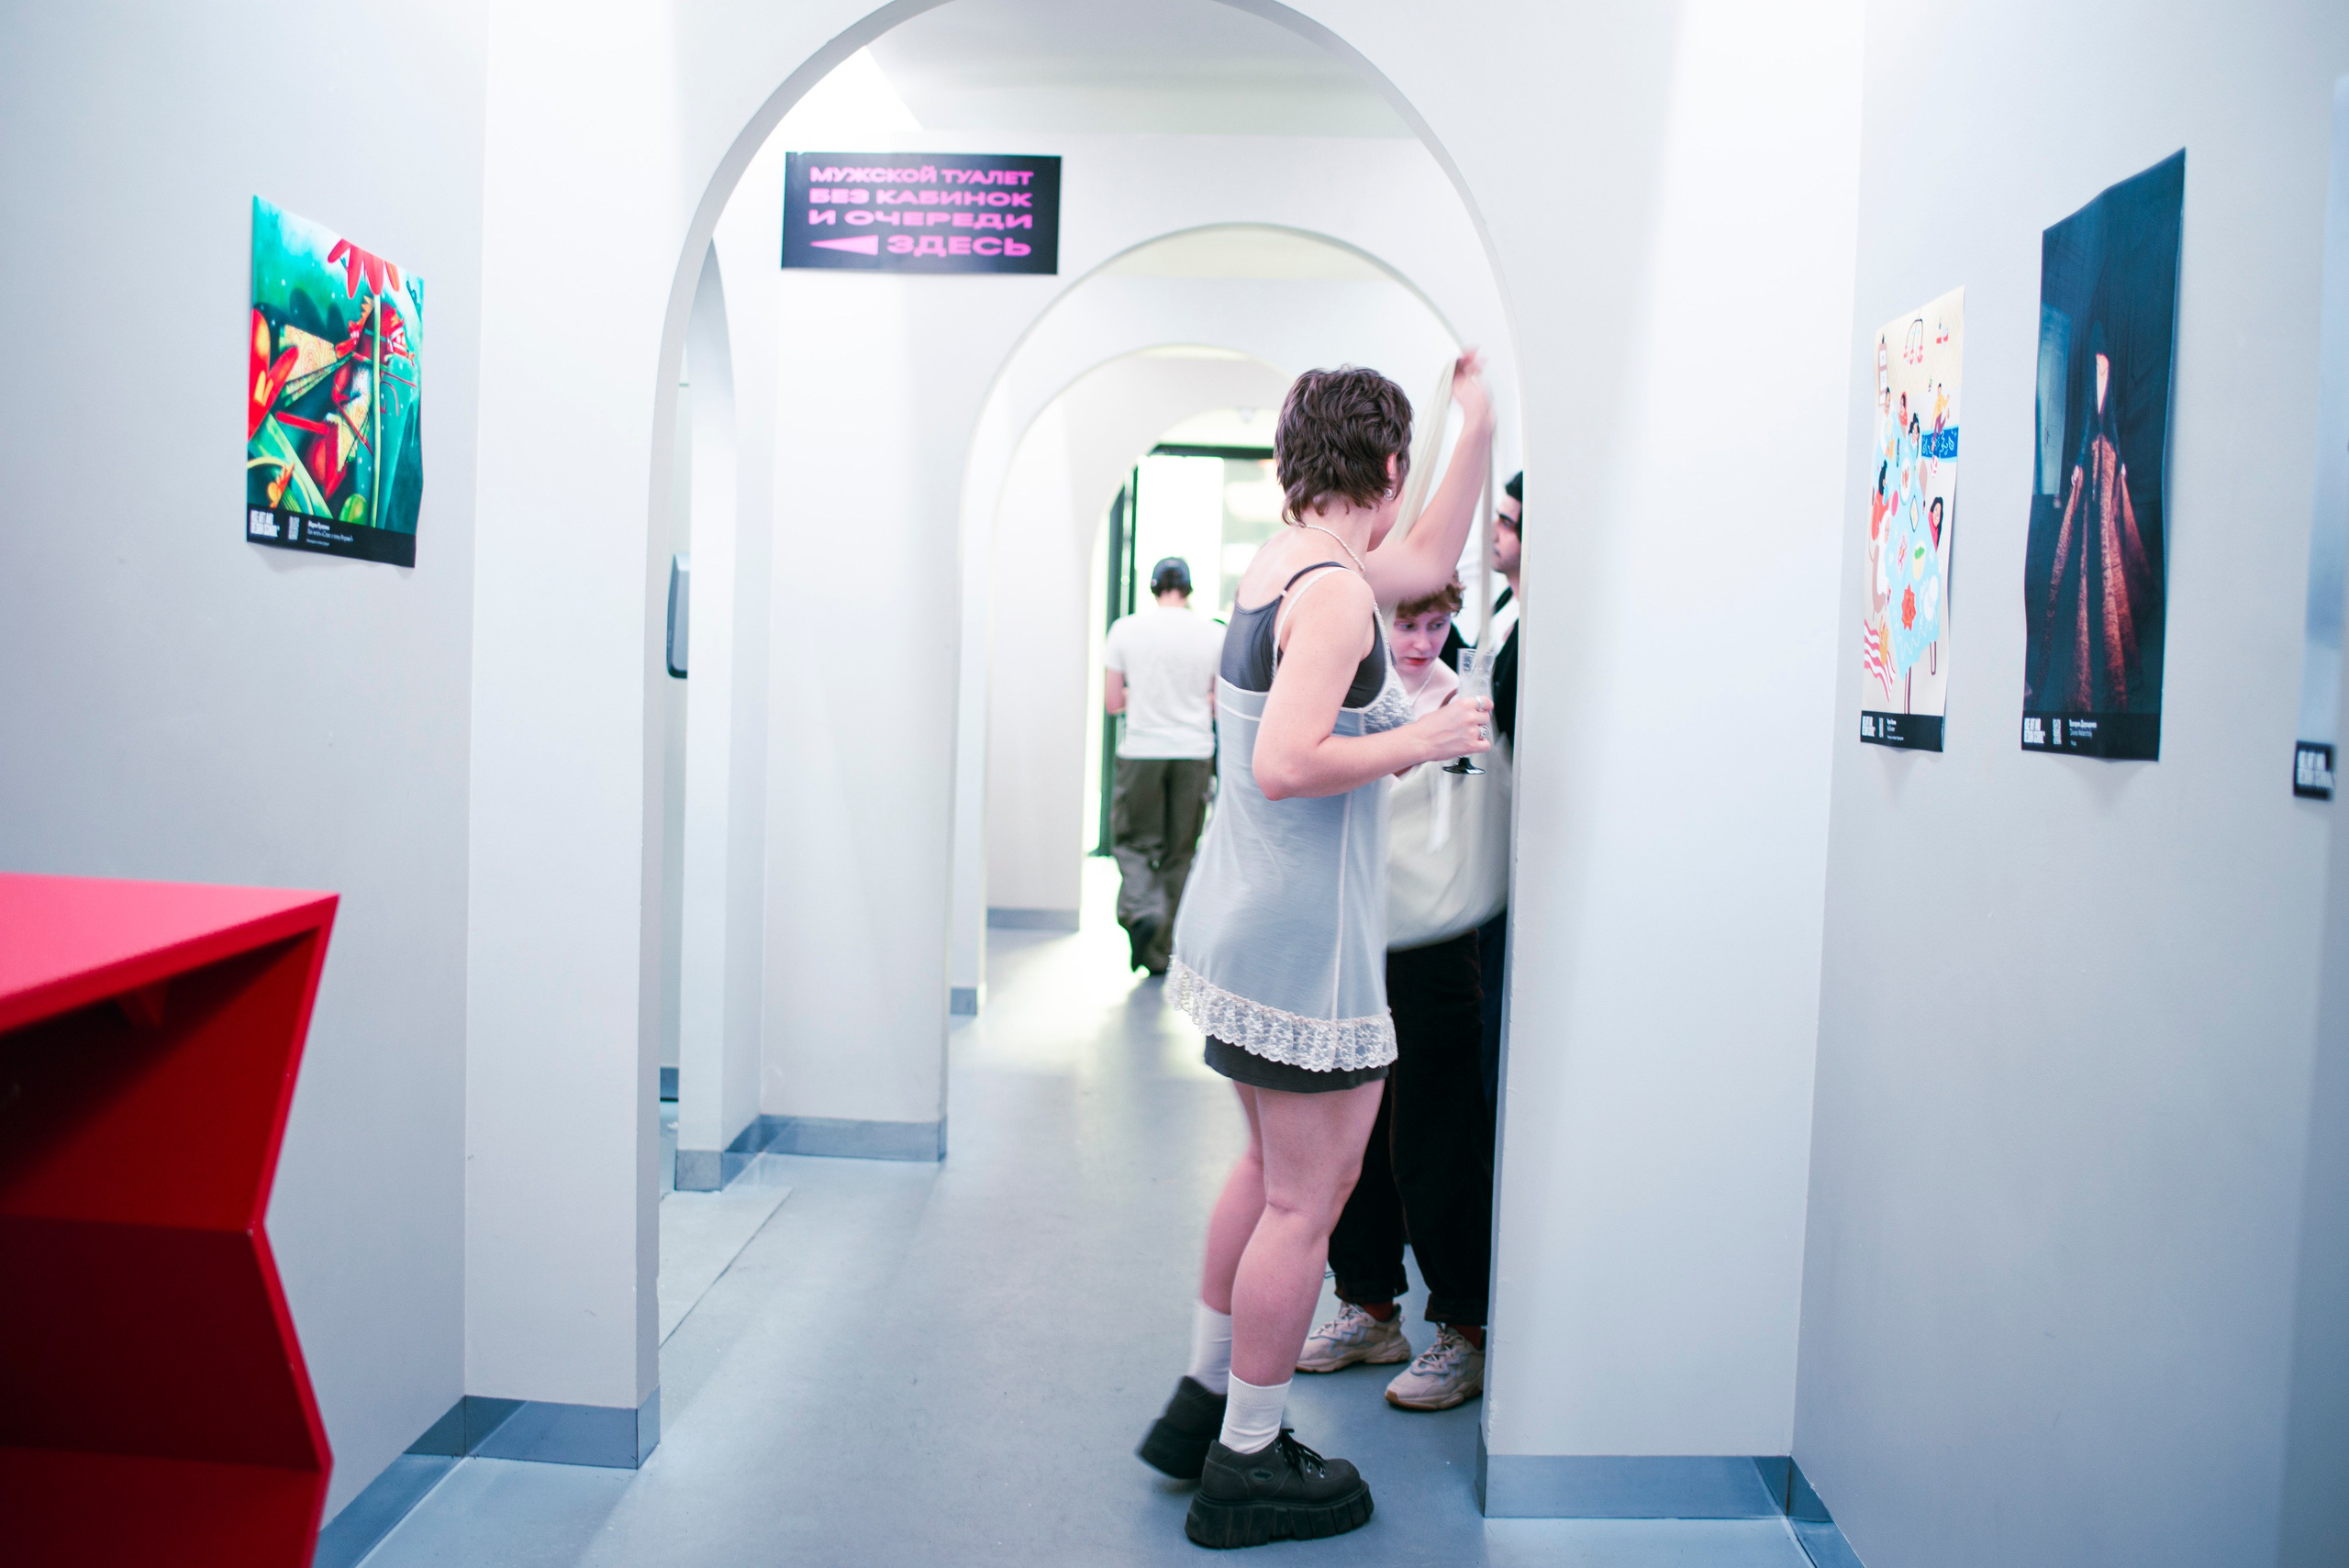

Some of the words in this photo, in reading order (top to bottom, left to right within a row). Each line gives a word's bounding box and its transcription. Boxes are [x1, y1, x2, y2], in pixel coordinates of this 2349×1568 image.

[810, 166, 937, 182] МУЖСКОЙ
[941, 170, 1034, 185] ТУАЛЕТ
[809, 187, 869, 204] БЕЗ
[876, 190, 1032, 207] КАБИНОК
[808, 209, 836, 226] И
[844, 210, 1033, 229] ОЧЕРЕДИ
[887, 235, 1031, 257] ЗДЕСЬ
